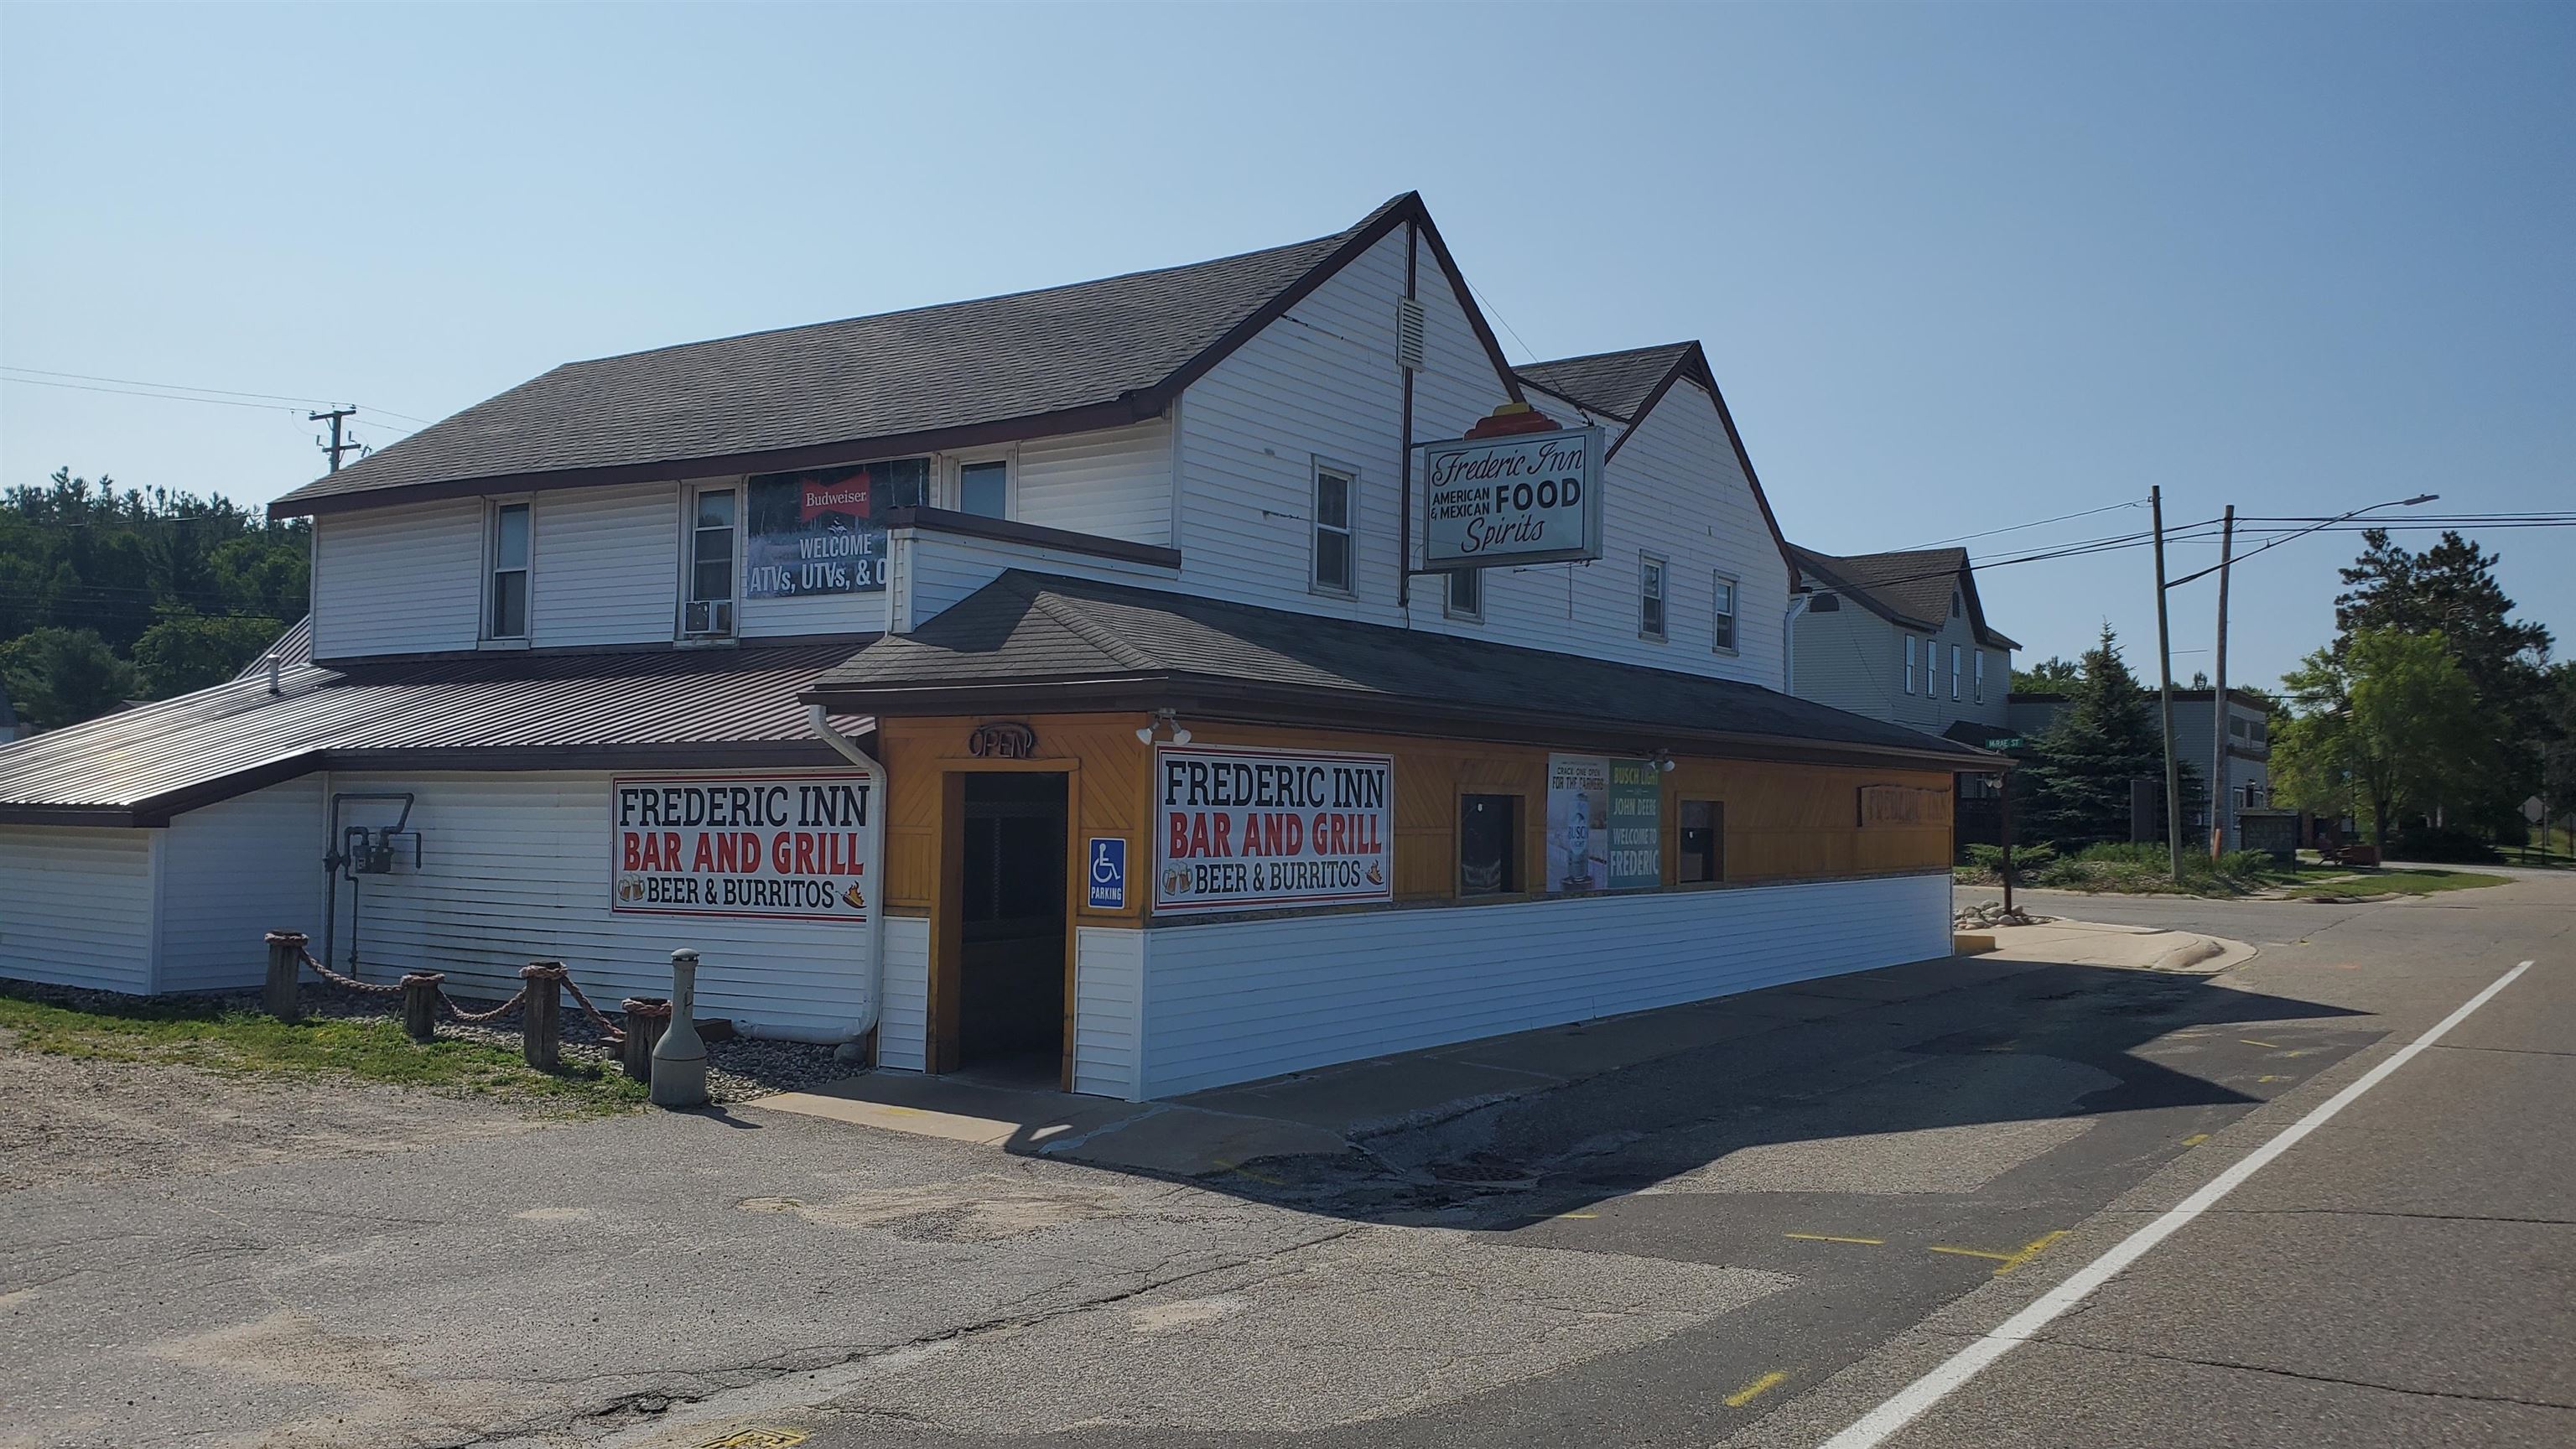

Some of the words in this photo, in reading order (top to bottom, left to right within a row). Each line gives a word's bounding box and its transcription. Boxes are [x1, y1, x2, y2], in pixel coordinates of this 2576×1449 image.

[1431, 449, 1526, 487] Frederic
[1526, 441, 1583, 475] Inn
[805, 489, 867, 507] Budweiser
[1432, 486, 1491, 506] AMERICAN
[1495, 476, 1581, 514] FOOD
[1430, 506, 1438, 521] &
[1440, 502, 1491, 520] MEXICAN
[799, 533, 873, 559] WELCOME
[1461, 513, 1545, 553] Spirits
[750, 565, 797, 594] ATVs,
[802, 561, 850, 591] UTVs,
[855, 558, 871, 586] &
[969, 730, 1028, 759] OPEN
[2010, 738, 2020, 747] ST
[1164, 761, 1326, 809] FREDERIC
[1332, 767, 1385, 809] INN
[1552, 776, 1564, 790] FOR
[1566, 776, 1578, 791] THE
[1555, 766, 1574, 776] CRACK
[1576, 767, 1587, 776] ONE
[1613, 766, 1639, 785] BUSCH
[619, 785, 789, 828] FREDERIC
[797, 785, 870, 828] INN
[1613, 797, 1636, 816] JOHN
[1637, 798, 1657, 817] DEERE
[1168, 812, 1233, 859] BAR
[1240, 812, 1304, 858] AND
[1311, 812, 1383, 856] GRILL
[1613, 828, 1649, 846] WELCOME
[1649, 828, 1658, 845] TO
[623, 831, 684, 873] BAR
[692, 832, 762, 875] AND
[771, 831, 865, 875] GRILL
[1610, 849, 1659, 878] FREDERIC
[1194, 863, 1249, 894] BEER
[1254, 863, 1265, 892] &
[1269, 860, 1361, 891] BURRITOS
[647, 876, 700, 905] BEER
[704, 877, 718, 906] &
[723, 878, 835, 909] BURRITOS
[1090, 886, 1123, 901] PARKING
